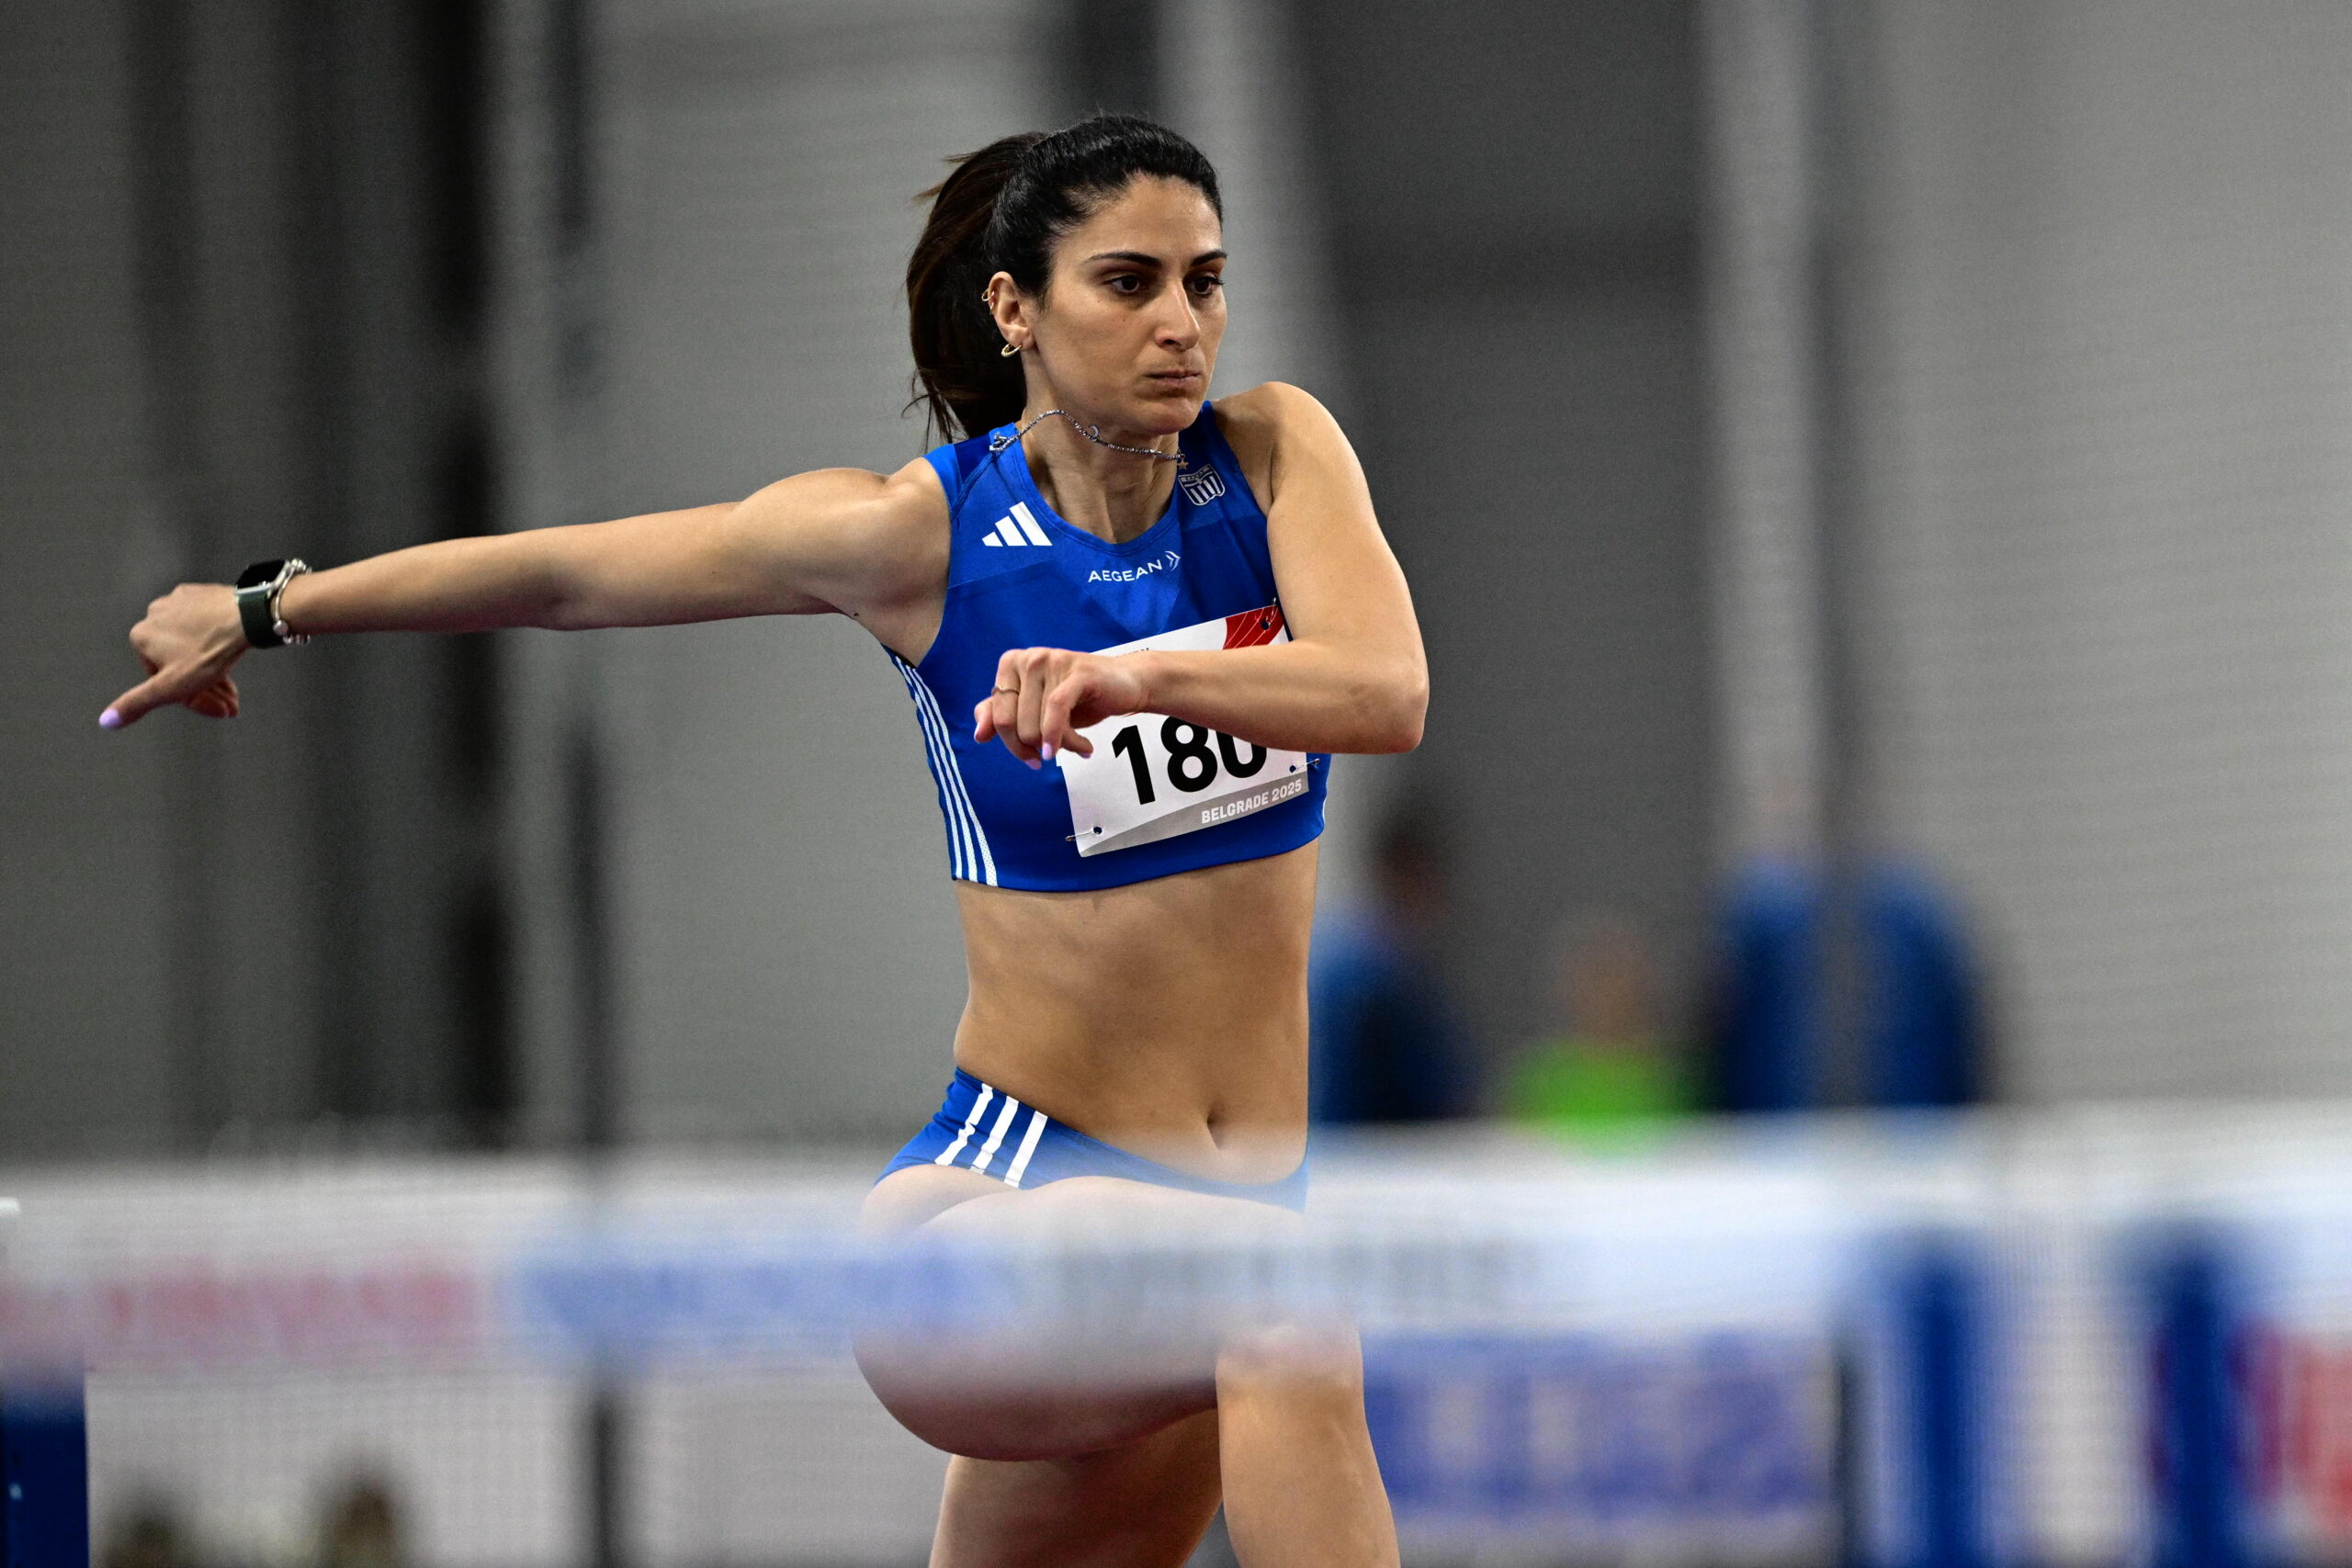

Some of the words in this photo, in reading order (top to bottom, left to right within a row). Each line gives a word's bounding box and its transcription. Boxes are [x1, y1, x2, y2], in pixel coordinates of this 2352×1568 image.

[1088, 559, 1163, 583] AEGEAN
[1201, 791, 1269, 824] BELGRADE
[1272, 779, 1302, 802] 2025
